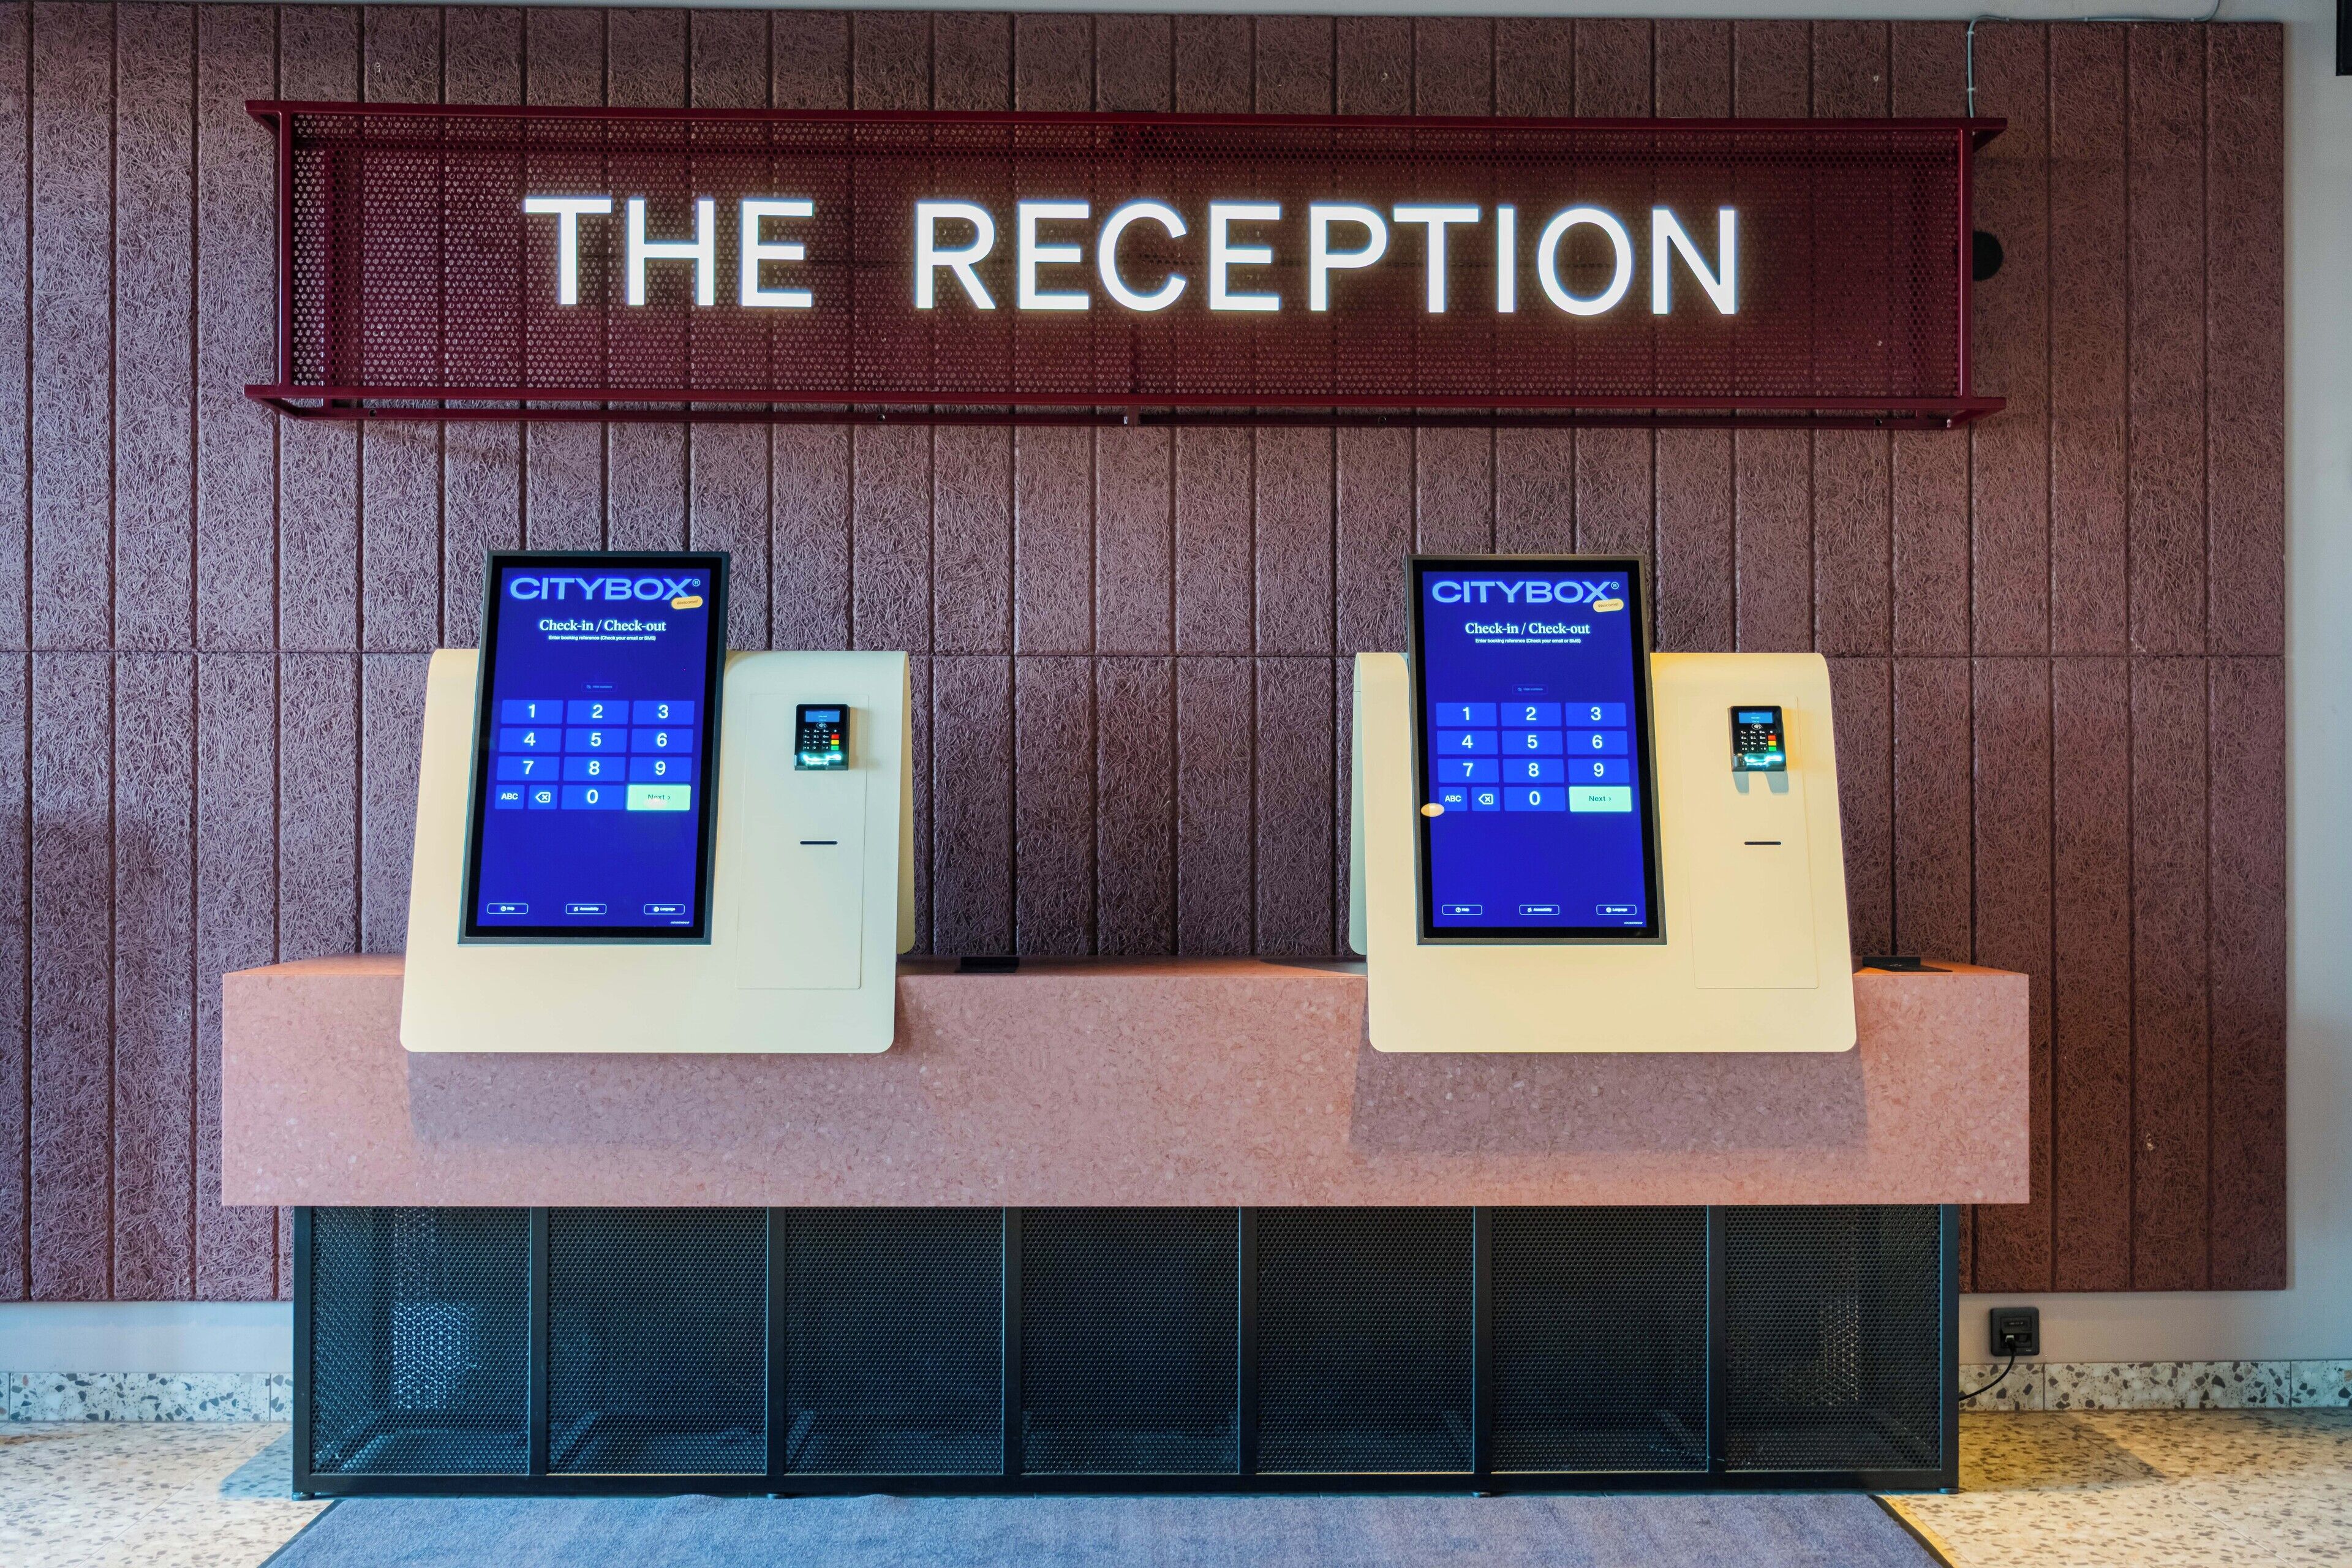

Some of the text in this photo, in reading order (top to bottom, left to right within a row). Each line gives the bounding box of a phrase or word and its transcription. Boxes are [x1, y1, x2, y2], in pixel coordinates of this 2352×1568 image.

[525, 198, 1736, 317] THE RECEPTION
[539, 619, 594, 631] Check-in
[603, 619, 667, 631] Check-out
[1464, 622, 1519, 634] Check-in
[1528, 622, 1591, 635] Check-out
[529, 704, 535, 718] 1
[592, 704, 603, 718] 2
[658, 705, 668, 718] 3
[1463, 707, 1469, 720] 1
[1526, 707, 1536, 720] 2
[1591, 707, 1601, 720] 3
[524, 733, 535, 746] 4
[590, 733, 601, 747] 5
[657, 733, 667, 747] 6
[1462, 735, 1472, 748] 4
[1528, 735, 1537, 748] 5
[1593, 735, 1602, 748] 6
[523, 761, 533, 774] 7
[589, 761, 600, 775] 8
[655, 761, 666, 775] 9
[1463, 763, 1473, 777] 7
[1528, 763, 1539, 777] 8
[1594, 763, 1604, 777] 9
[587, 790, 598, 804] 0
[1529, 791, 1540, 805] 0
